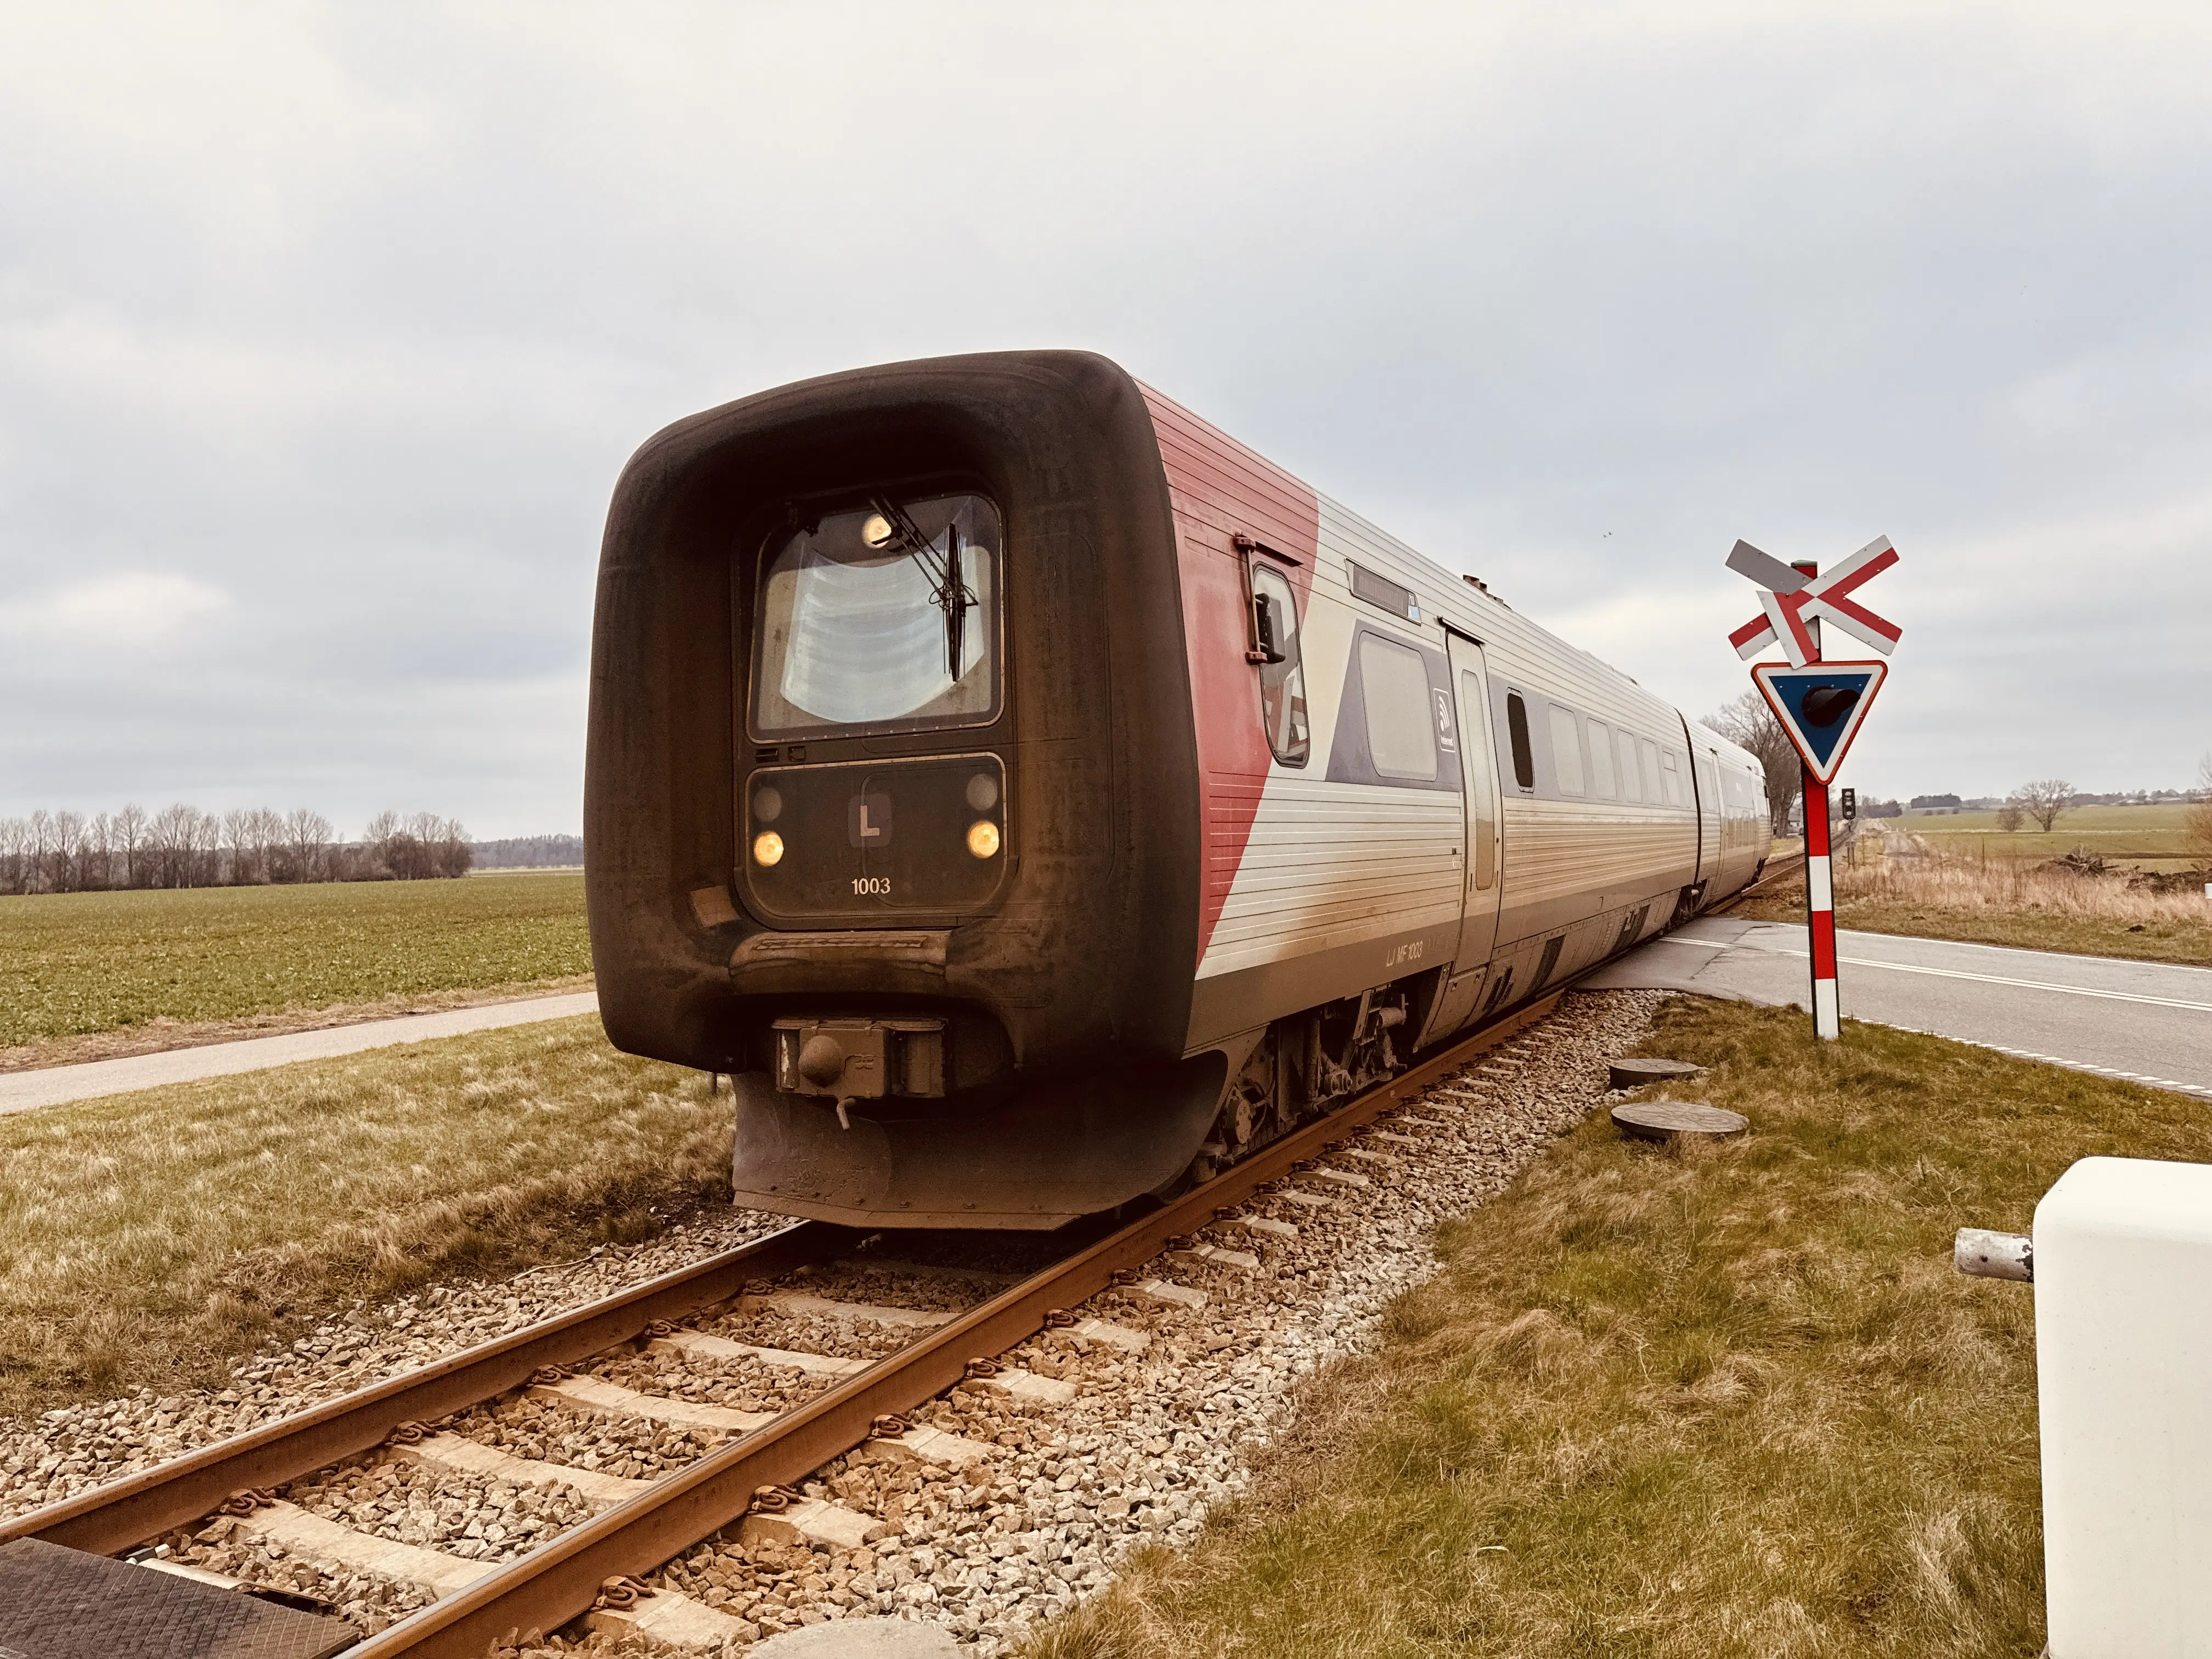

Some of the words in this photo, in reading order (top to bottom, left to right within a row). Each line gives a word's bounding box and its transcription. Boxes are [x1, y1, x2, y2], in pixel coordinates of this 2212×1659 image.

[860, 805, 880, 837] L
[851, 878, 891, 894] 1003
[1396, 945, 1408, 964] MF
[1408, 940, 1423, 961] 1003
